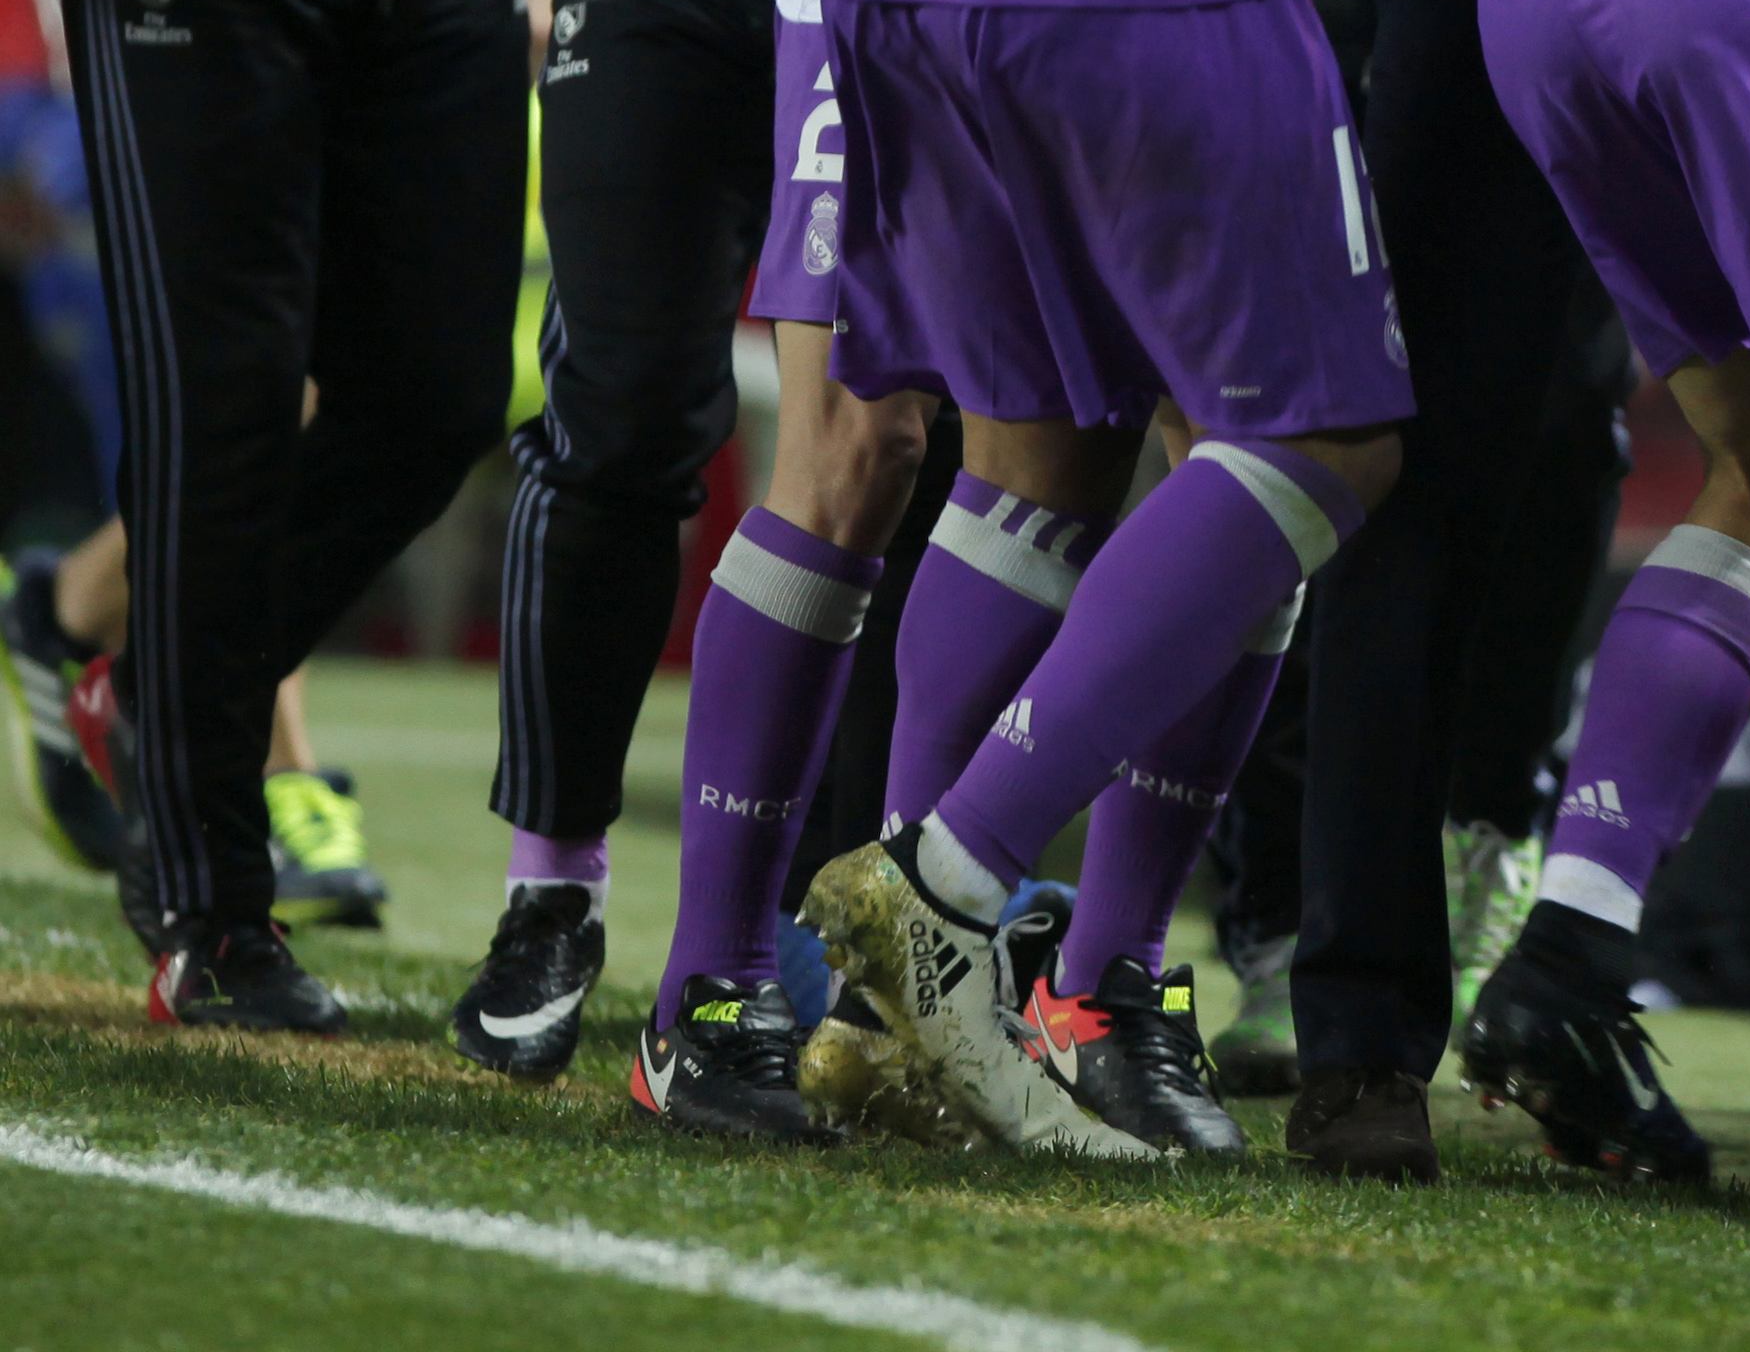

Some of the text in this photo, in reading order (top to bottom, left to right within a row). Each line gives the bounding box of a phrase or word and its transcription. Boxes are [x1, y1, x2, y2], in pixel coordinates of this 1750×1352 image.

[909, 919, 938, 1018] adidas
[691, 999, 743, 1024] NIKE
[1162, 985, 1192, 1012] NIKE
